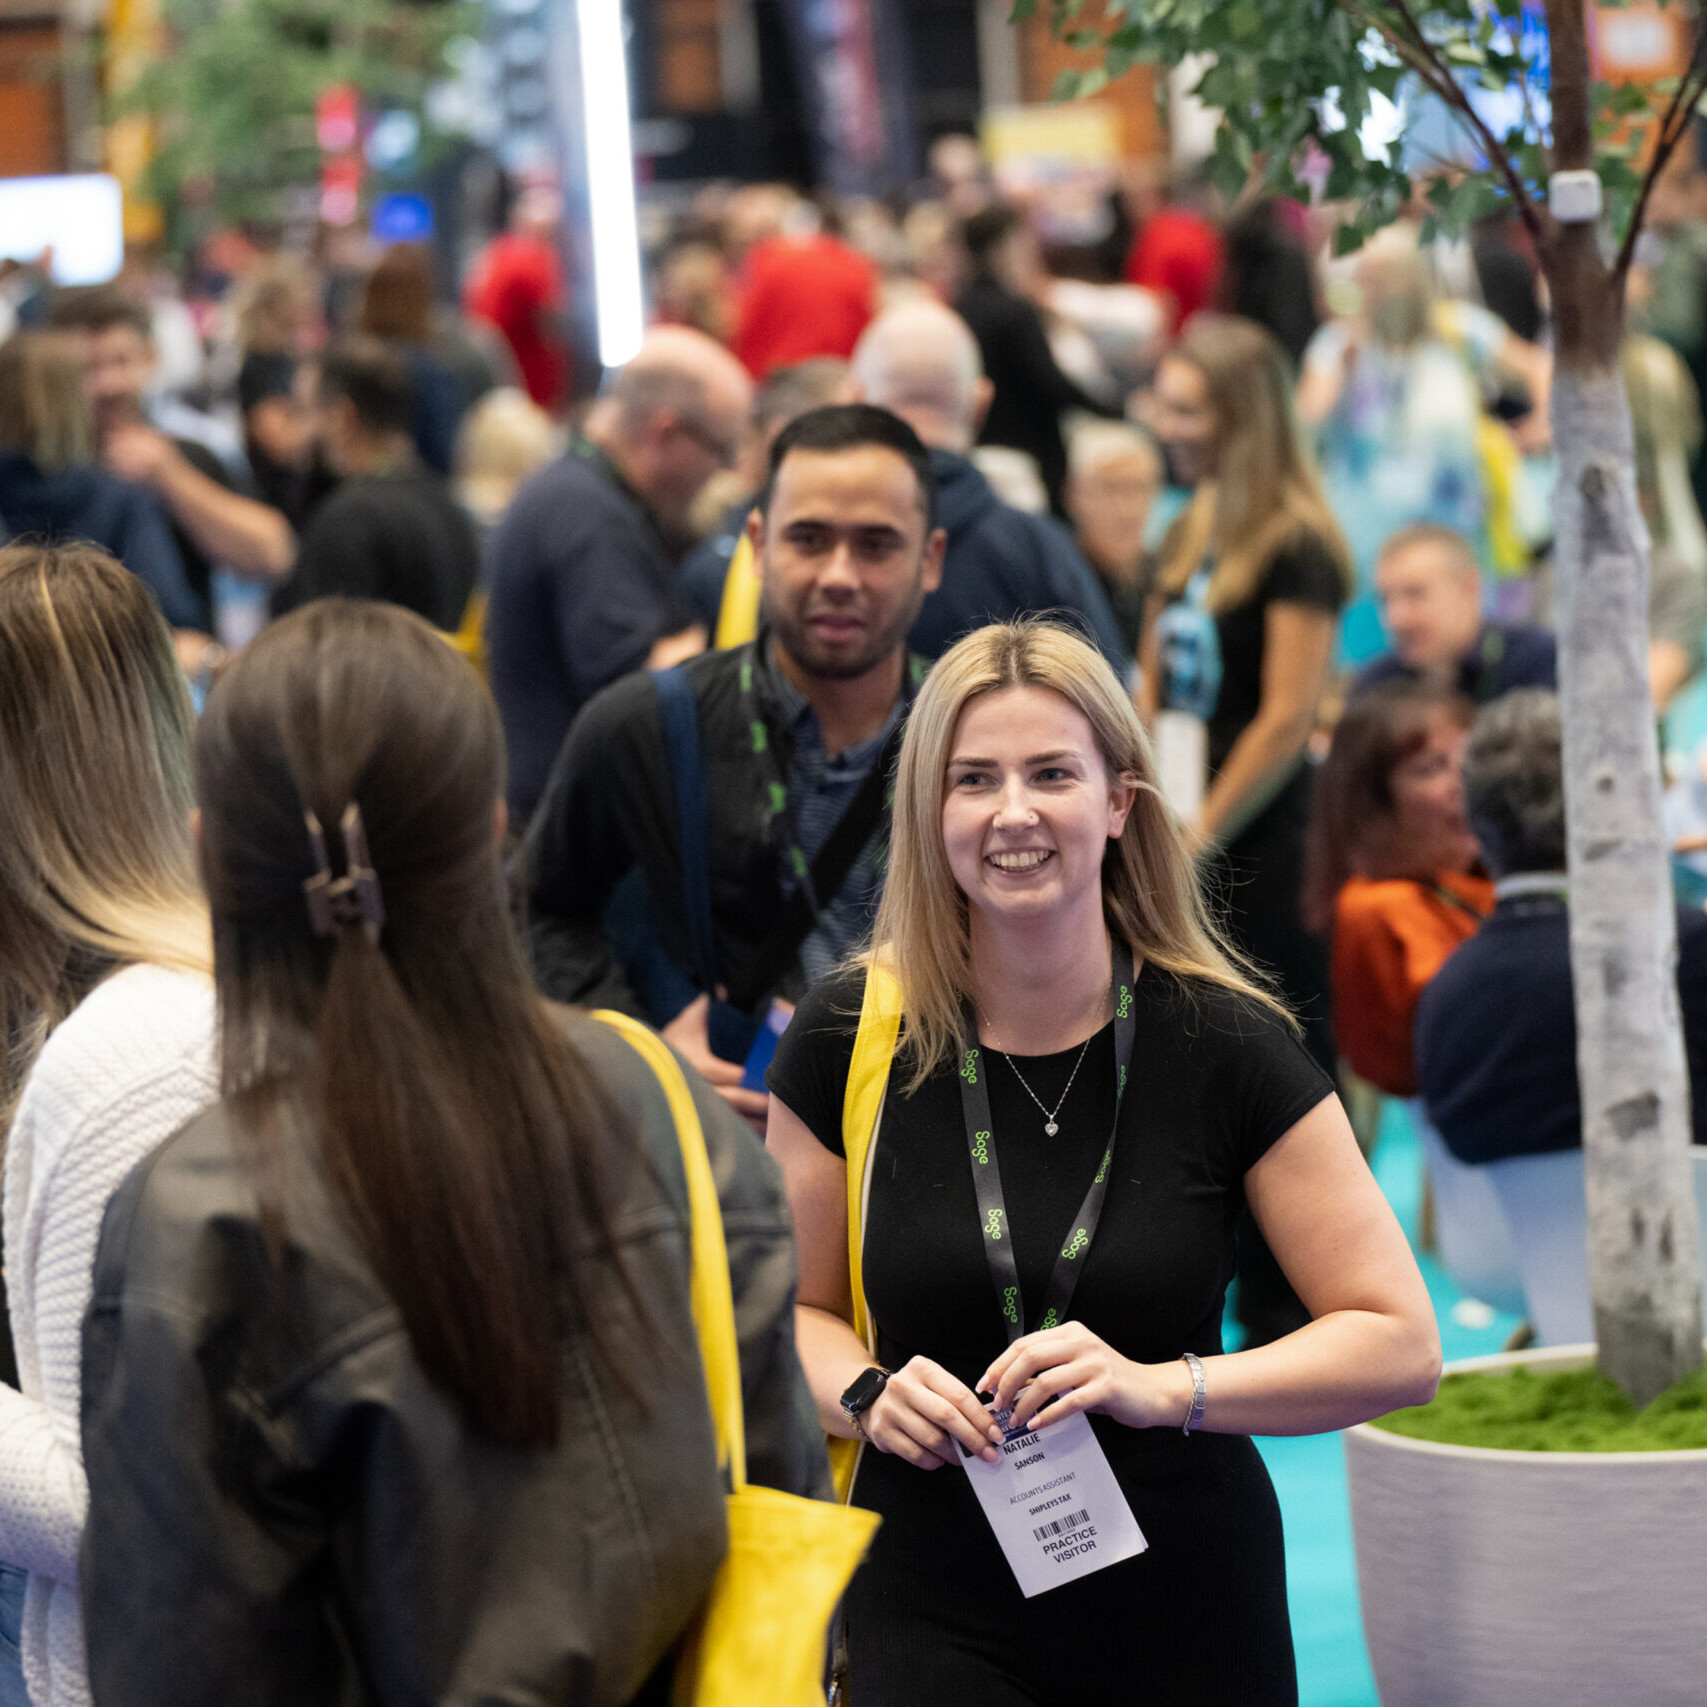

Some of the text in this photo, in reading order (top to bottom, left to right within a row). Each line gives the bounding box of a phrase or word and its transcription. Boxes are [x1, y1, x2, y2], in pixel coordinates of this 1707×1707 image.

[1116, 985, 1133, 1018] Sage
[960, 1048, 979, 1084] Sage
[970, 1130, 990, 1164] Sage
[984, 1208, 1002, 1240] Sage
[1061, 1228, 1089, 1260] Sage
[1003, 1286, 1018, 1323] Sage
[1040, 1308, 1058, 1331] age
[1003, 1432, 1041, 1455] NATALIE
[1014, 1451, 1045, 1470] SANSON
[1009, 1471, 1076, 1504] ACCOUNTS ASSISTANT
[1028, 1493, 1072, 1516] SHIPLEYS TAX
[1043, 1526, 1097, 1555] PRACTICE
[1053, 1540, 1097, 1563] VISITOR
